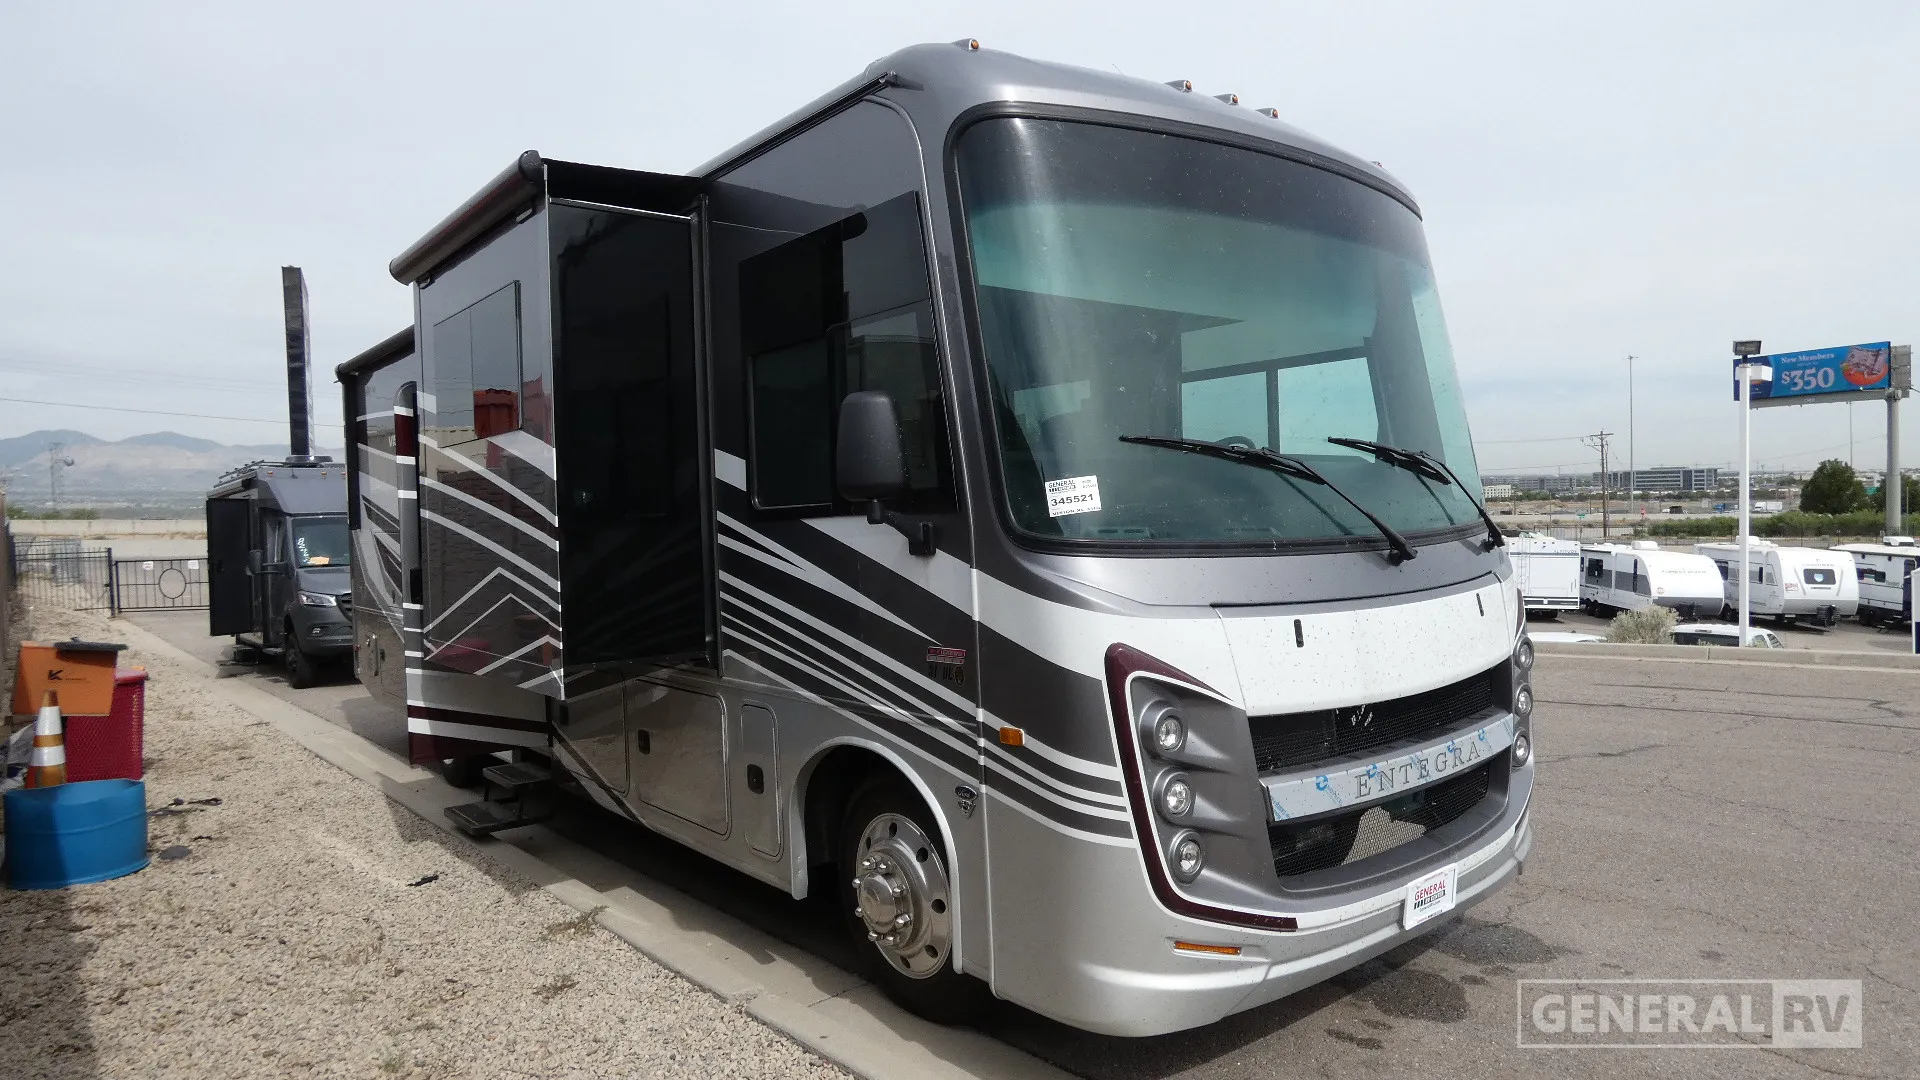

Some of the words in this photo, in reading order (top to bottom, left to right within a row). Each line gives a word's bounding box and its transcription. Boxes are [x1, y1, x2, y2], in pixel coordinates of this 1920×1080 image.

[1798, 353, 1835, 361] Members
[1781, 367, 1835, 390] $350
[1049, 480, 1076, 488] GENERAL
[1050, 494, 1093, 507] 345521
[1354, 741, 1480, 799] ENTEGRA
[1414, 879, 1446, 901] GENERAL
